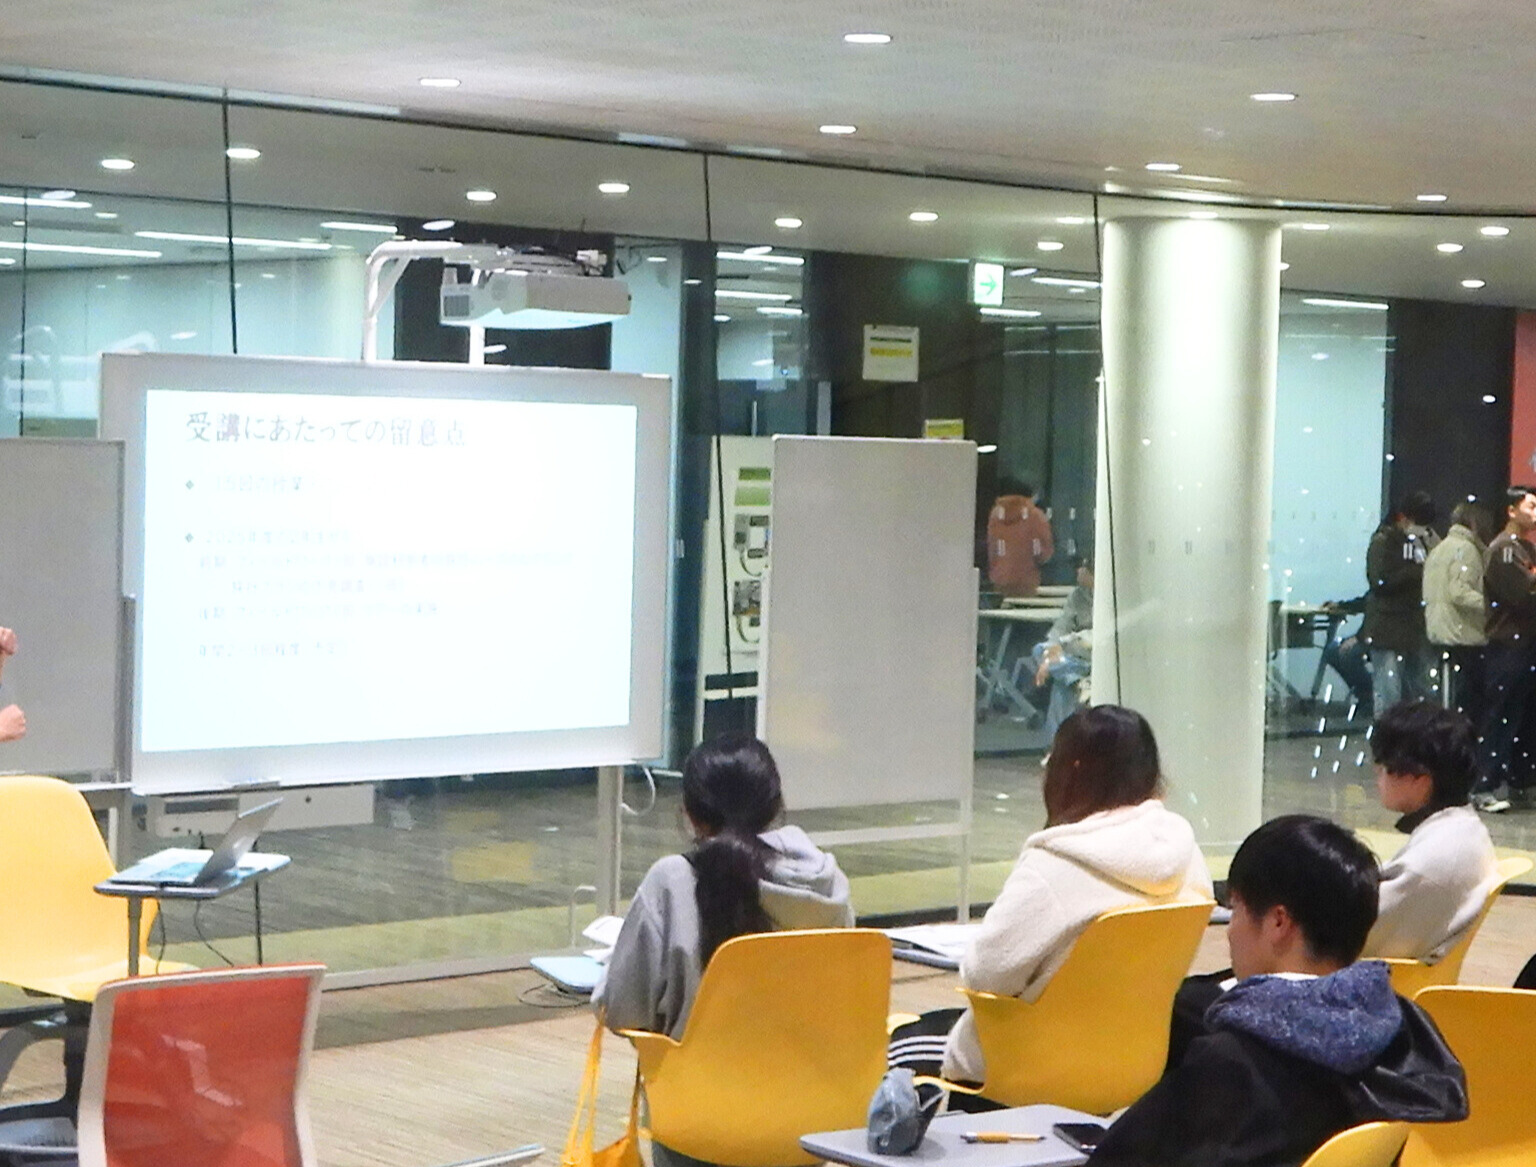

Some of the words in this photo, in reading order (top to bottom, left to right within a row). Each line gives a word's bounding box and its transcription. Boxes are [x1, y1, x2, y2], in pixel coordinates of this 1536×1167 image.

[185, 410, 466, 447] 受講にあたっての留意点
